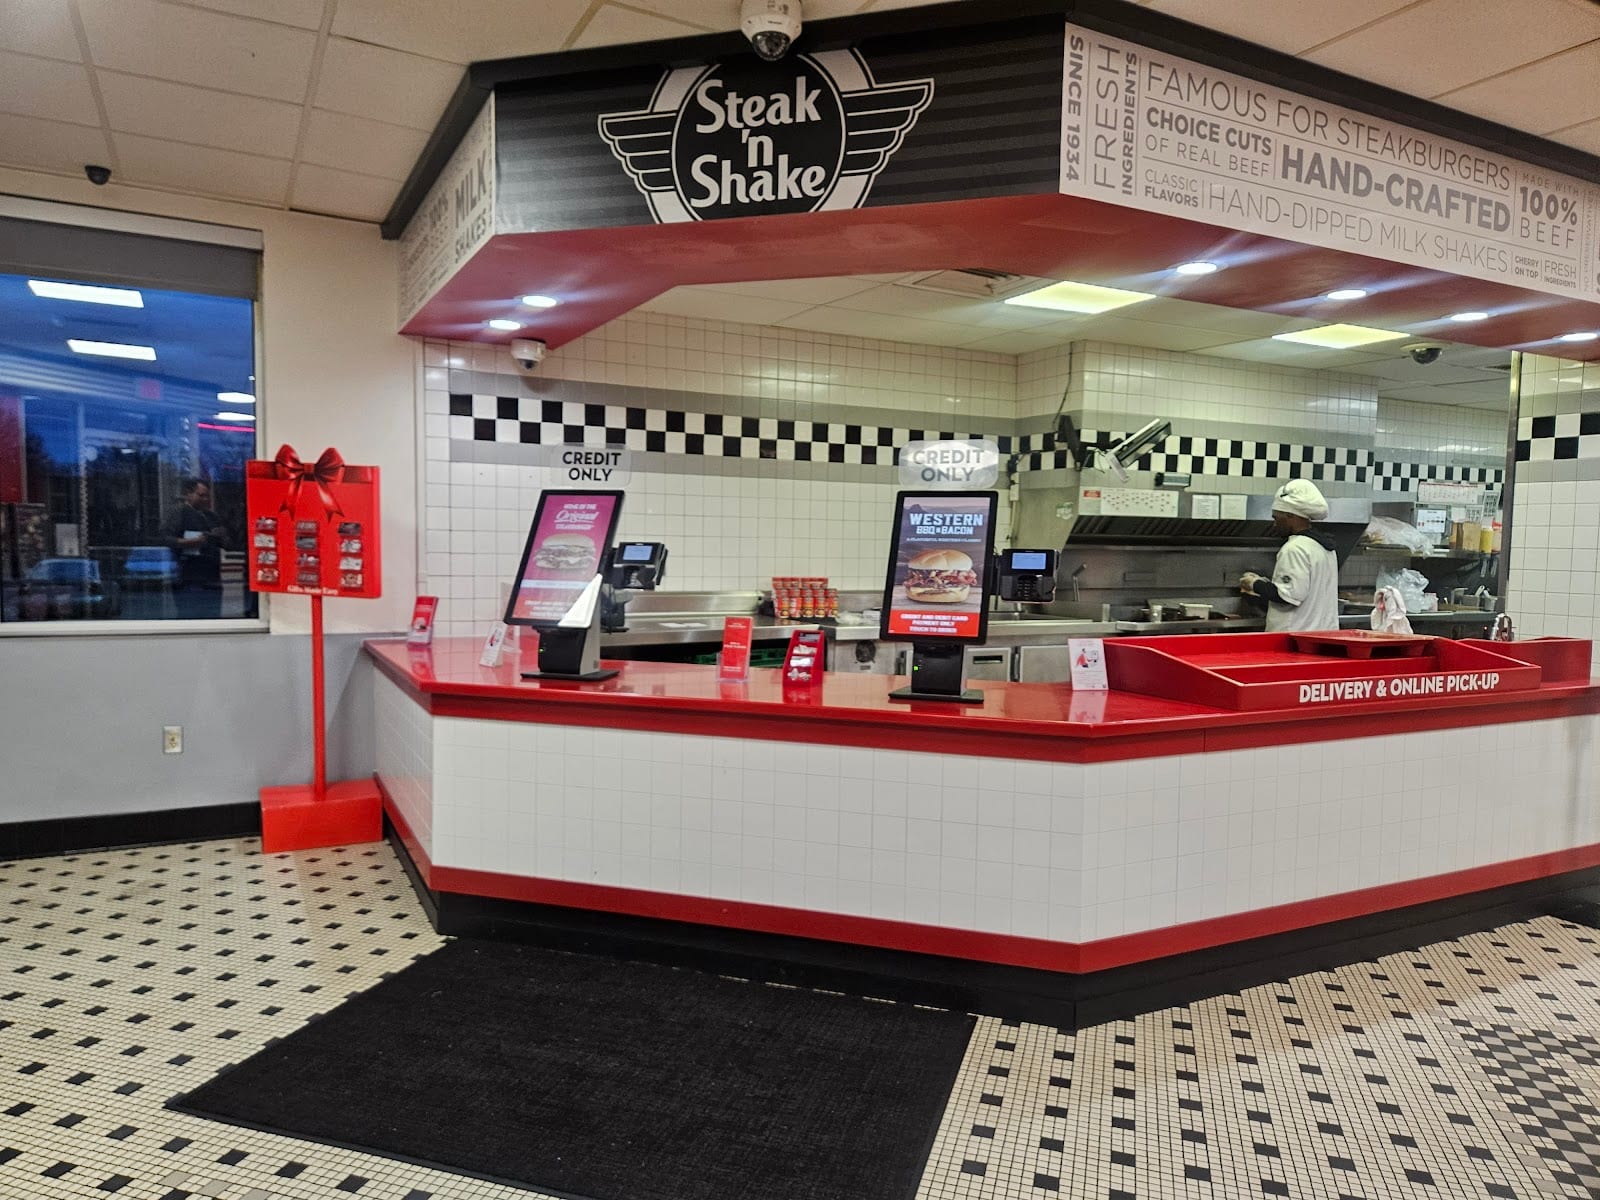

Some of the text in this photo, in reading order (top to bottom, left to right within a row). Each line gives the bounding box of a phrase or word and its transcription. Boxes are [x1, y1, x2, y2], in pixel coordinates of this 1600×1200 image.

[696, 76, 821, 133] Steak
[1066, 34, 1084, 181] SINCE 1934
[1094, 44, 1120, 188] FRESH
[1122, 52, 1137, 195] INGREDIENTS
[1146, 107, 1272, 156] CHOICE CUTS
[1148, 61, 1510, 191] FAMOUS FOR STEAKBURGERS
[1145, 134, 1269, 177] OF REAL BEEF
[455, 150, 487, 229] MILK
[690, 154, 826, 208] Shake
[1145, 169, 1198, 192] CLASSIC
[1145, 185, 1198, 207] FLAVORS
[1281, 144, 1511, 232] HAND-CRAFTED
[1520, 186, 1577, 226] 100%
[455, 208, 487, 264] SHAKES
[1209, 183, 1508, 272] HAND-DIPPED MILK SHAKES
[1520, 217, 1575, 248] BEEF
[1514, 256, 1539, 268] CHERRY
[1514, 268, 1539, 280] ON TOP
[1544, 260, 1577, 279] FRESH
[1544, 276, 1577, 288] INGREDIENTS
[562, 452, 622, 466] CREDIT
[913, 449, 985, 465] CREDIT
[568, 467, 613, 482] ONLY
[921, 467, 975, 482] ONLY
[909, 513, 984, 526] WESTERN
[916, 525, 936, 534] BBQ
[941, 526, 974, 535] BACON
[1299, 673, 1500, 703] DELIVERY & ONLINE PICK-UP
